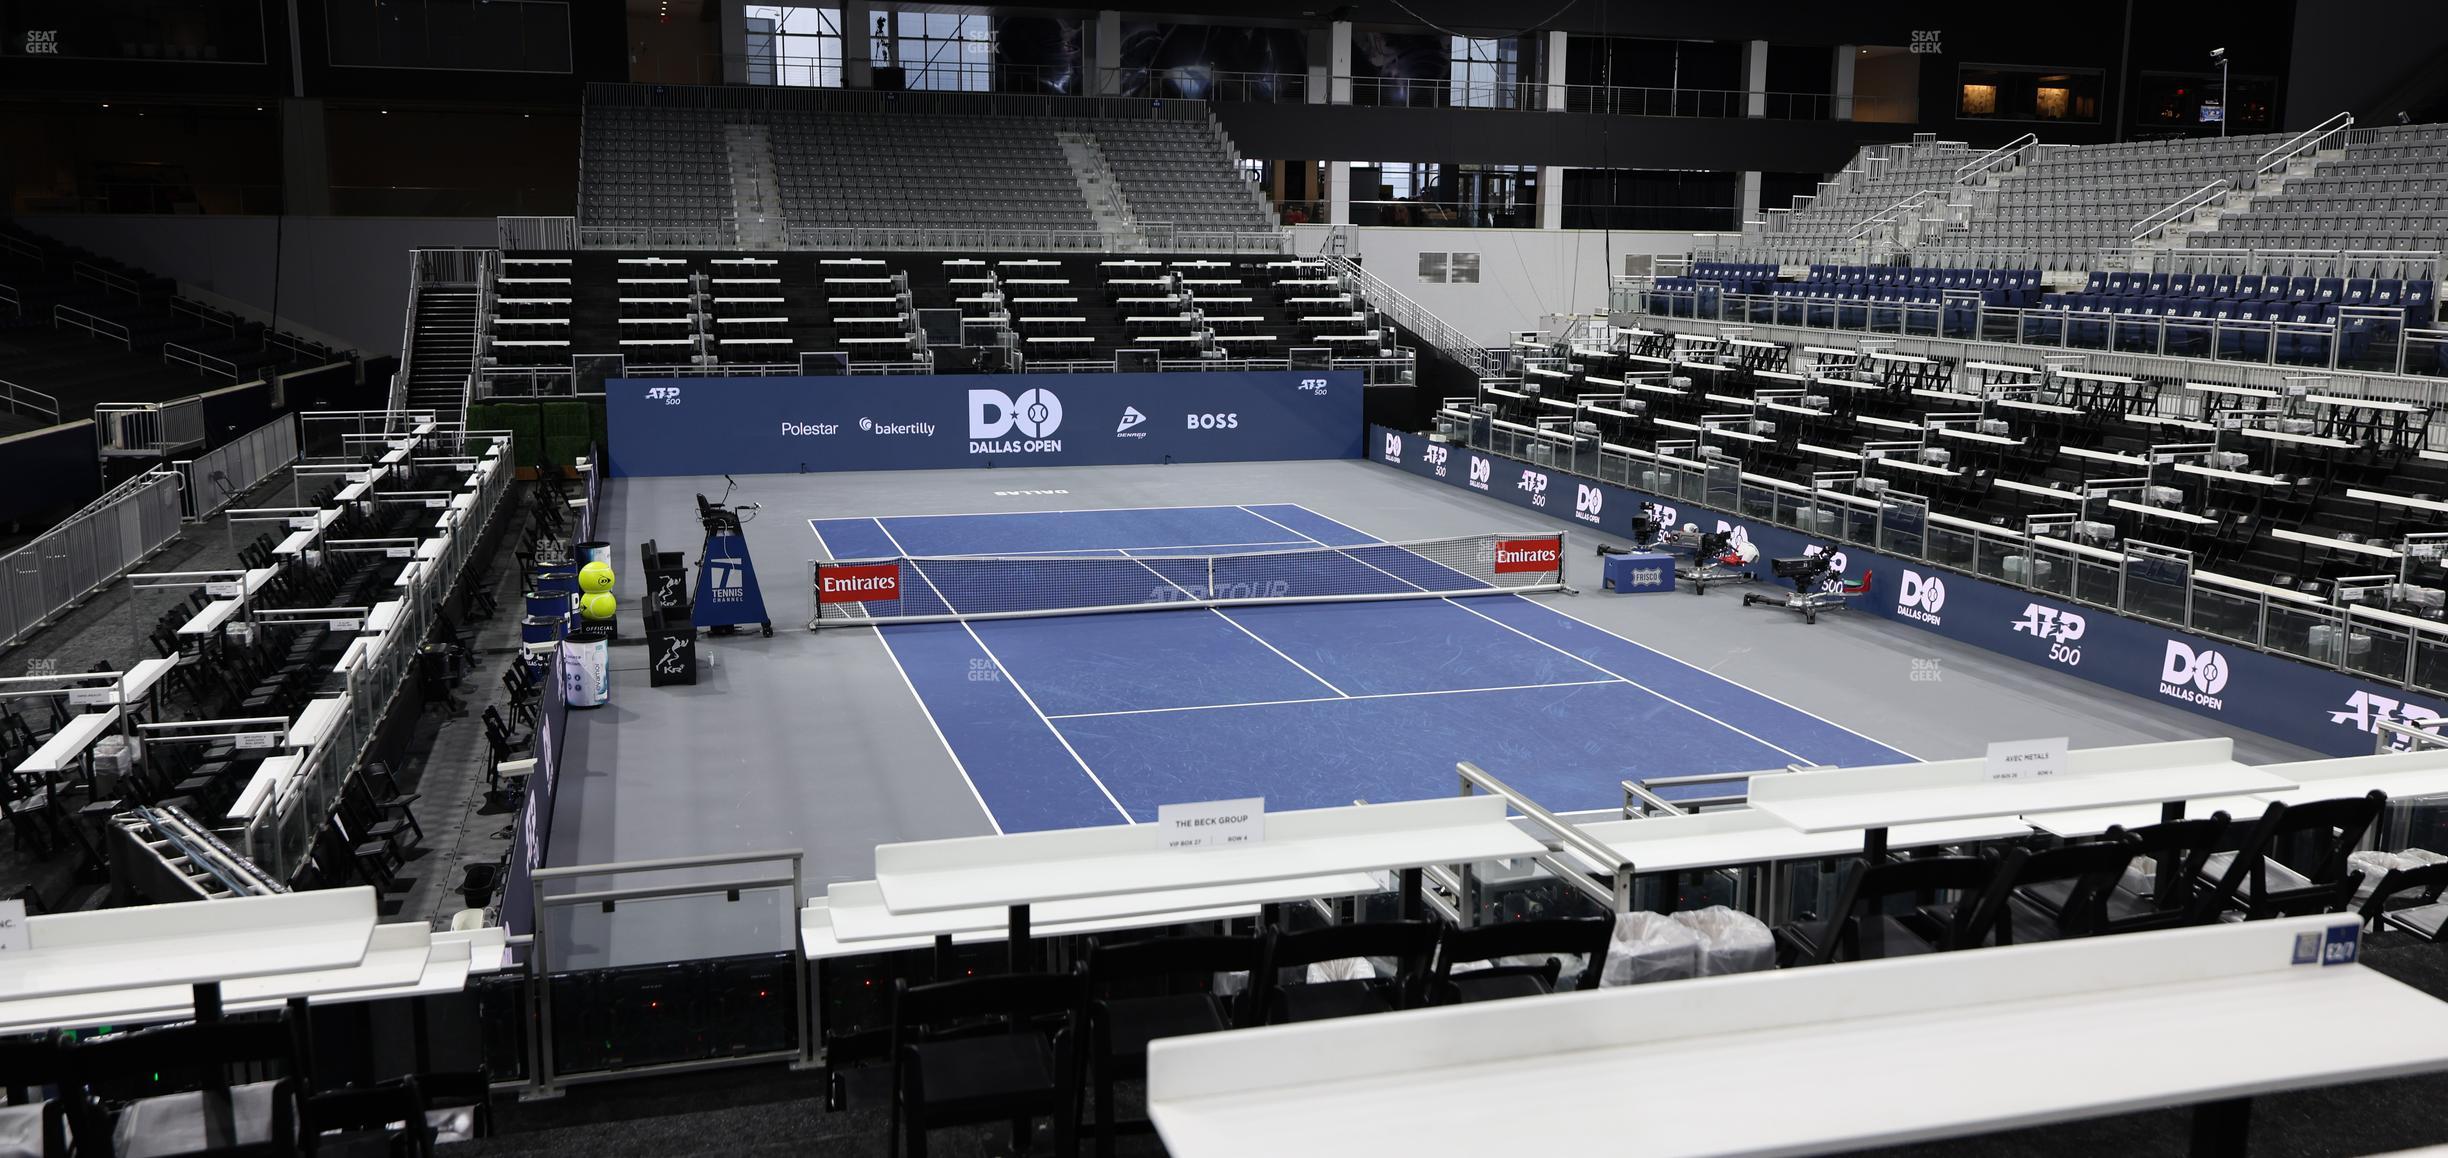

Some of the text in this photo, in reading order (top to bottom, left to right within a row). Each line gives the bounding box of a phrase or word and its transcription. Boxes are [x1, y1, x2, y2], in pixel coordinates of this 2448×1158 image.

[1297, 379, 1327, 390] ATP
[645, 387, 681, 399] ATP
[968, 388, 1063, 439] DO
[1187, 413, 1238, 429] BOSS
[782, 422, 839, 436] Polestar
[875, 422, 935, 437] bakertilly
[969, 440, 1062, 454] DALLAS OPEN
[1422, 444, 1448, 465] ATP
[1435, 465, 1447, 477] 500
[1516, 469, 1548, 494] ATP
[1532, 493, 1546, 507] 500
[1497, 548, 1556, 563] Emirates
[823, 576, 896, 592] Emirates
[1636, 572, 1658, 581] FRISCO
[712, 588, 743, 598] TENNIS
[1898, 569, 1946, 614] DO
[1897, 604, 1941, 626] DALLAS OPEN
[2010, 602, 2086, 643] ATP
[2048, 643, 2081, 666] 500
[2161, 639, 2229, 695] DO
[2159, 681, 2223, 711] DALLAS OPEN
[1176, 814, 1249, 829] THE BECK GROUP
